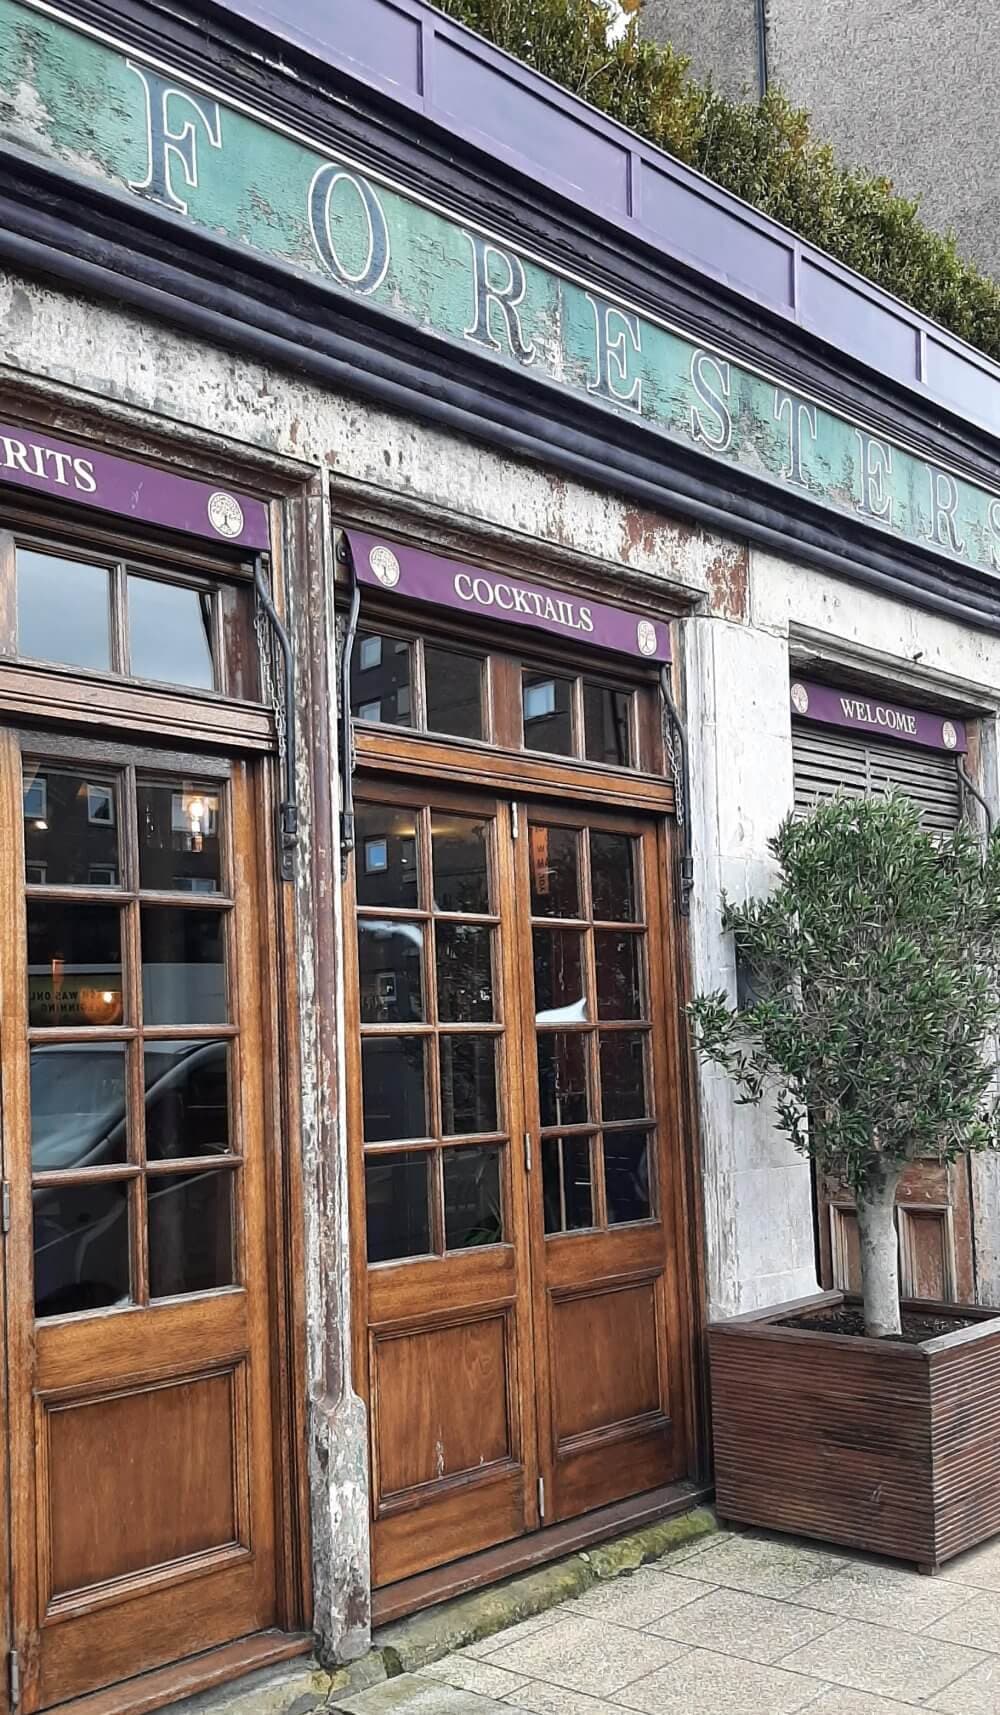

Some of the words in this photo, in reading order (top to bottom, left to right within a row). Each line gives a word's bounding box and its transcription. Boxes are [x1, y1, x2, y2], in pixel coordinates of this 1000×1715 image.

[0, 435, 97, 492] RITS
[454, 573, 594, 632] COCKTAILS
[840, 697, 917, 735] WELCOME
